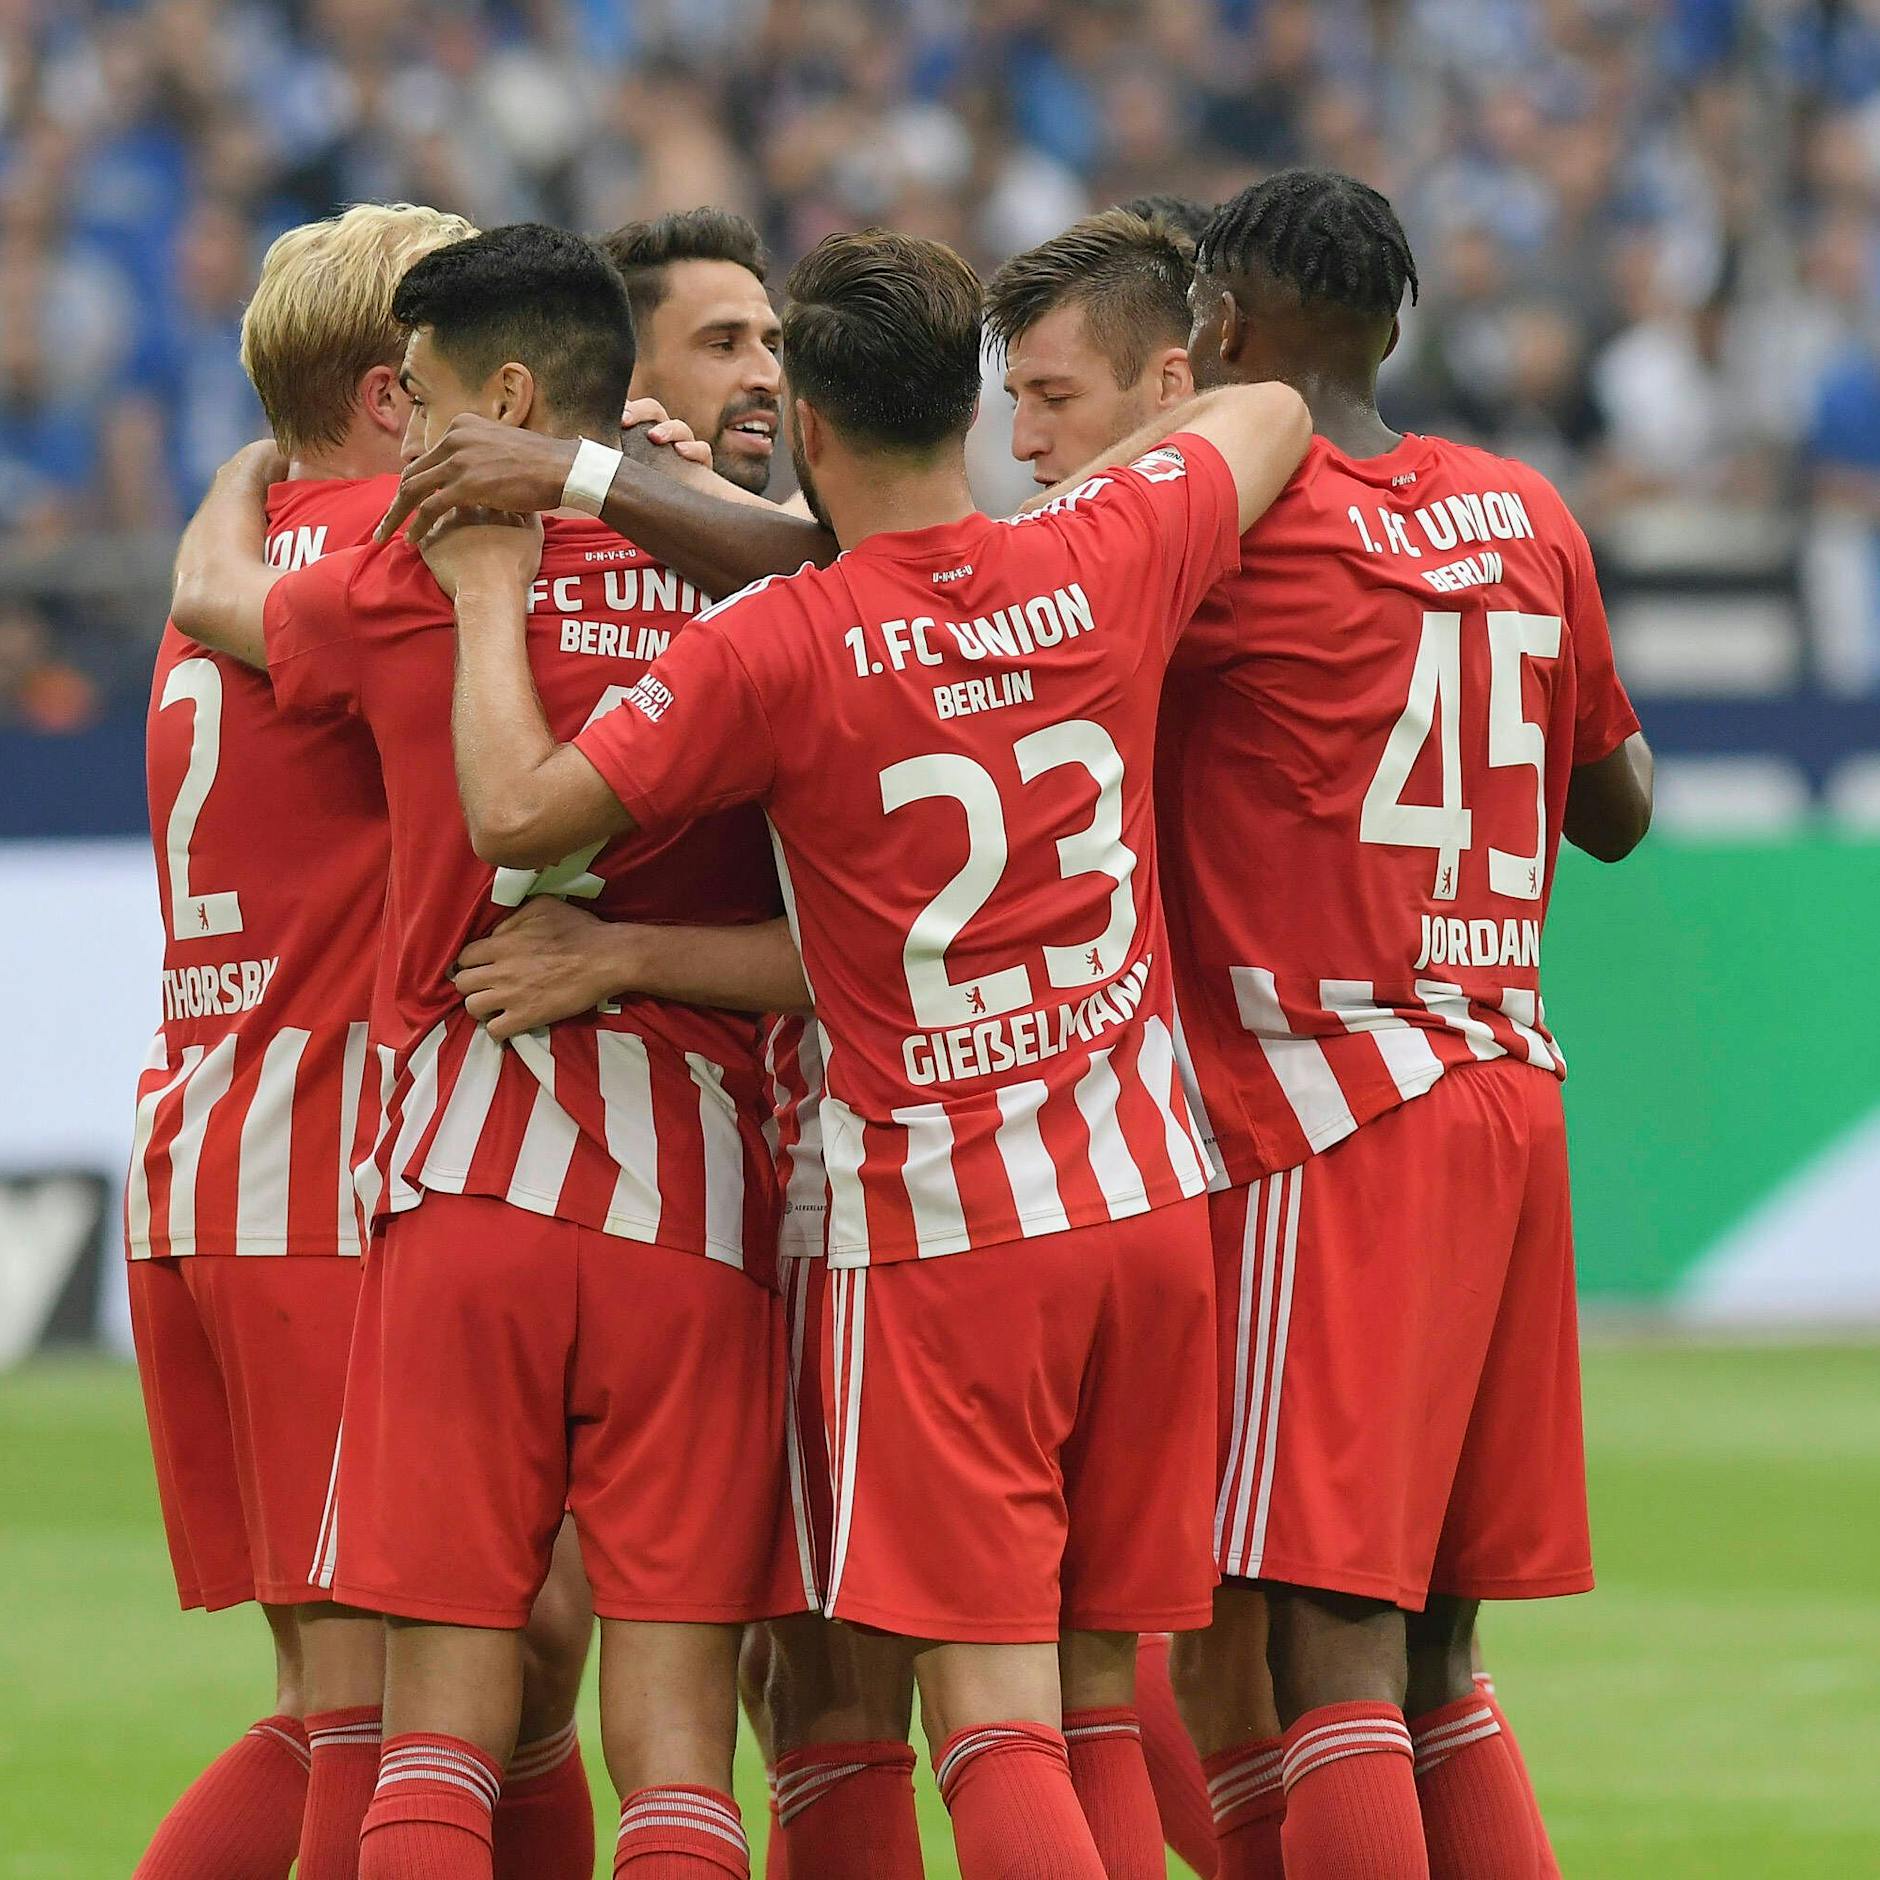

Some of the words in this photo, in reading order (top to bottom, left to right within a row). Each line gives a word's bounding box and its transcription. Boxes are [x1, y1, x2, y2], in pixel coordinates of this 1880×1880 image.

[1414, 491, 1535, 551] UNION
[604, 568, 712, 613] UNI
[1421, 552, 1503, 592] BERLIN
[560, 618, 671, 661] BERLIN
[945, 583, 1096, 660] UNION
[637, 673, 675, 710] MEDY
[933, 669, 1034, 720] BERLIN
[1359, 611, 1562, 900] 45
[159, 658, 243, 941] 2
[879, 719, 1137, 1028] 23
[1413, 914, 1540, 971] JORDAN
[162, 956, 279, 1020] THORSBY
